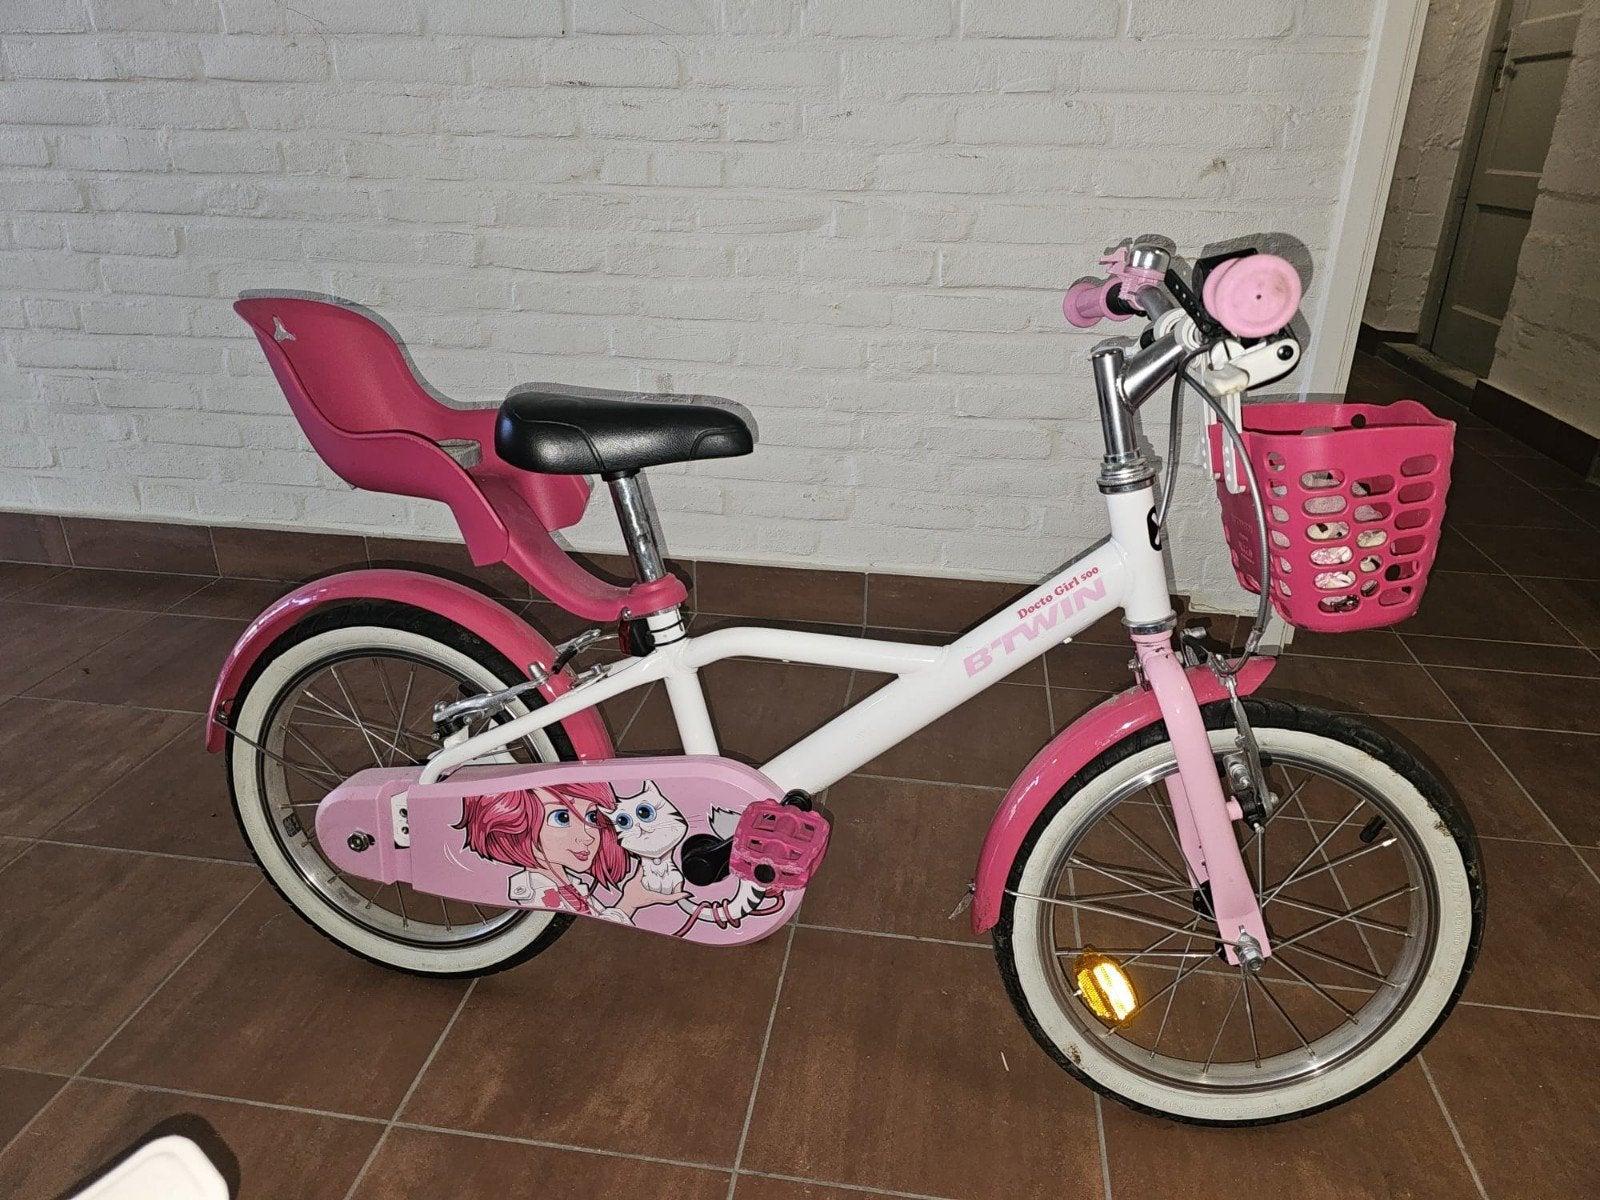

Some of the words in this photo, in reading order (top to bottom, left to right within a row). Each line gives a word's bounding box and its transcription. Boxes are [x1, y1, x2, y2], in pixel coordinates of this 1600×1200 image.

[1017, 594, 1053, 620] Docto
[1054, 577, 1080, 596] Girl
[1081, 566, 1099, 581] 500
